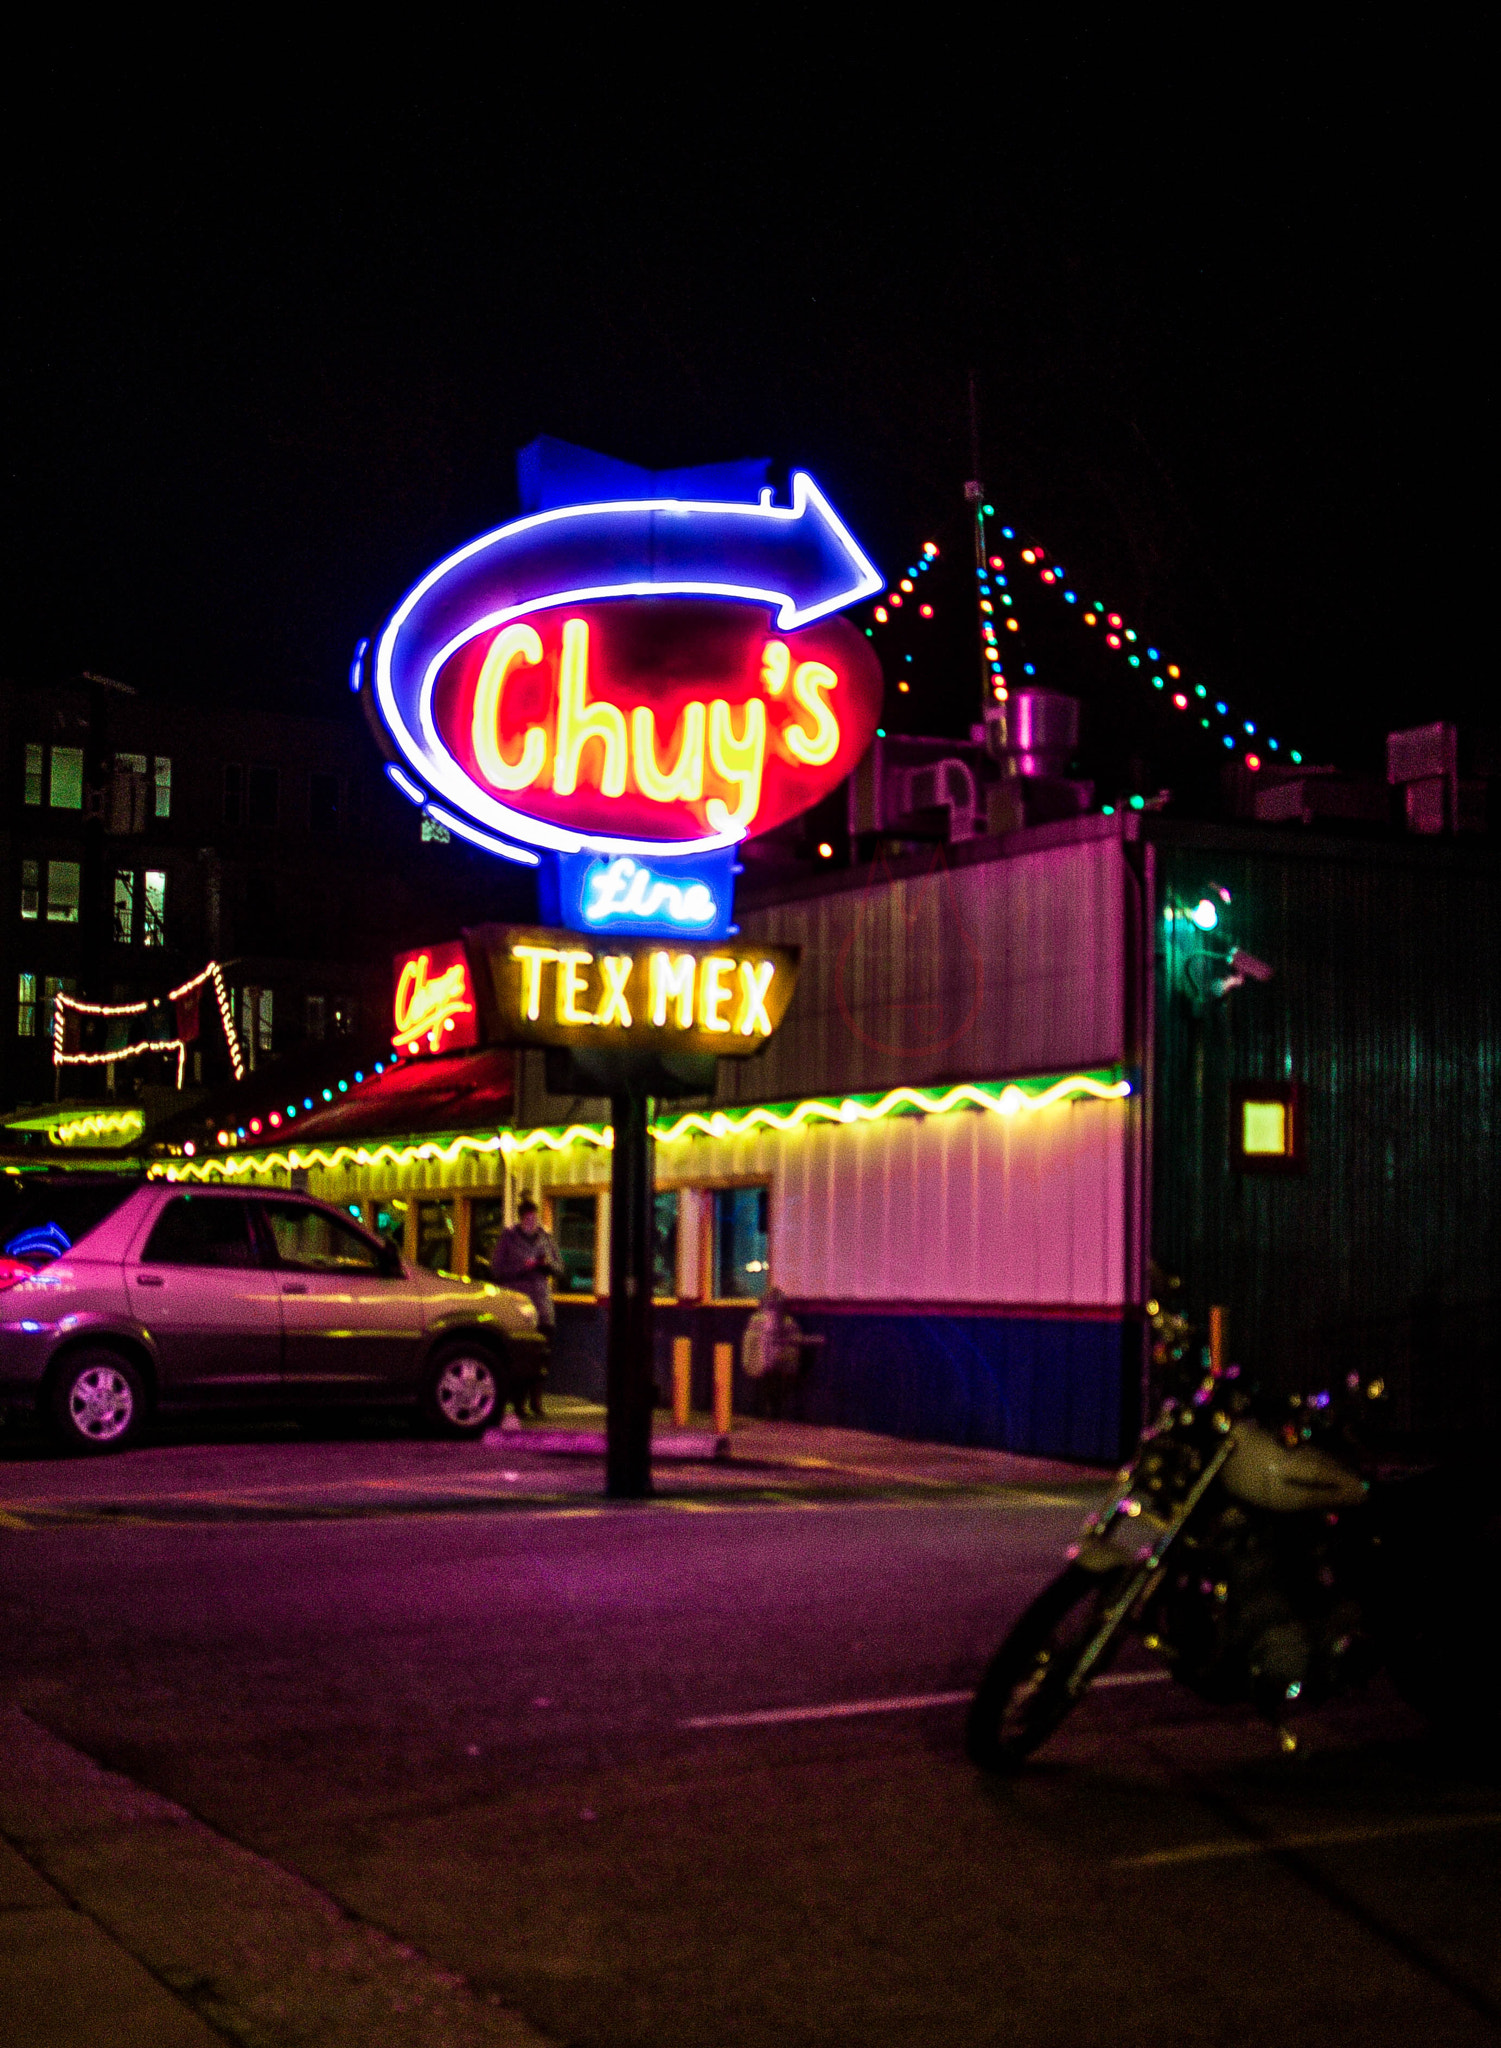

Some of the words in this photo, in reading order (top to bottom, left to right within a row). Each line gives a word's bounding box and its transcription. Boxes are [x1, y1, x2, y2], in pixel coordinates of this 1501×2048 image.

[471, 618, 840, 833] Chuy's
[511, 945, 632, 1028] TEX
[649, 951, 775, 1036] MEX
